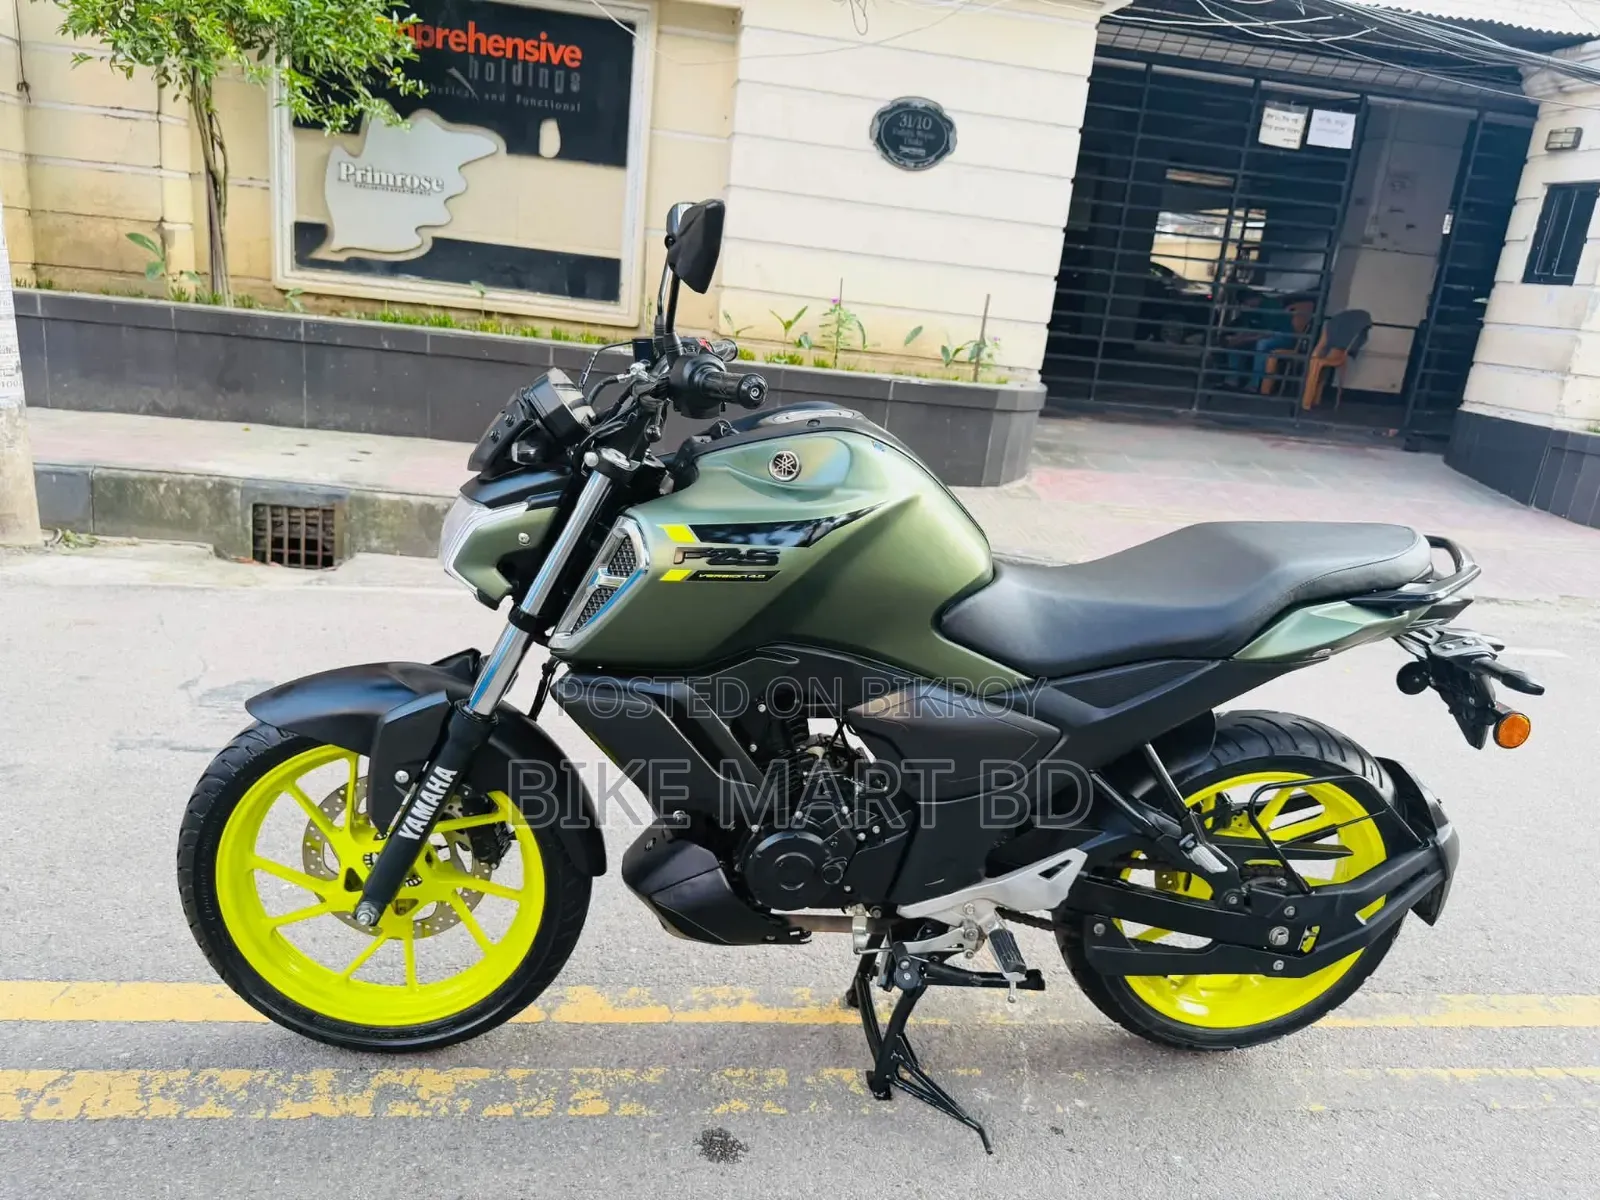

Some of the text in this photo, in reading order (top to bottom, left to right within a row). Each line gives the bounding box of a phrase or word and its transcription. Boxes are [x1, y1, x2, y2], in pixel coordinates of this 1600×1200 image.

[468, 54, 581, 93] holdings
[899, 113, 933, 131] 31/10
[337, 161, 445, 194] Primrose
[398, 765, 458, 840] YAMAHA
